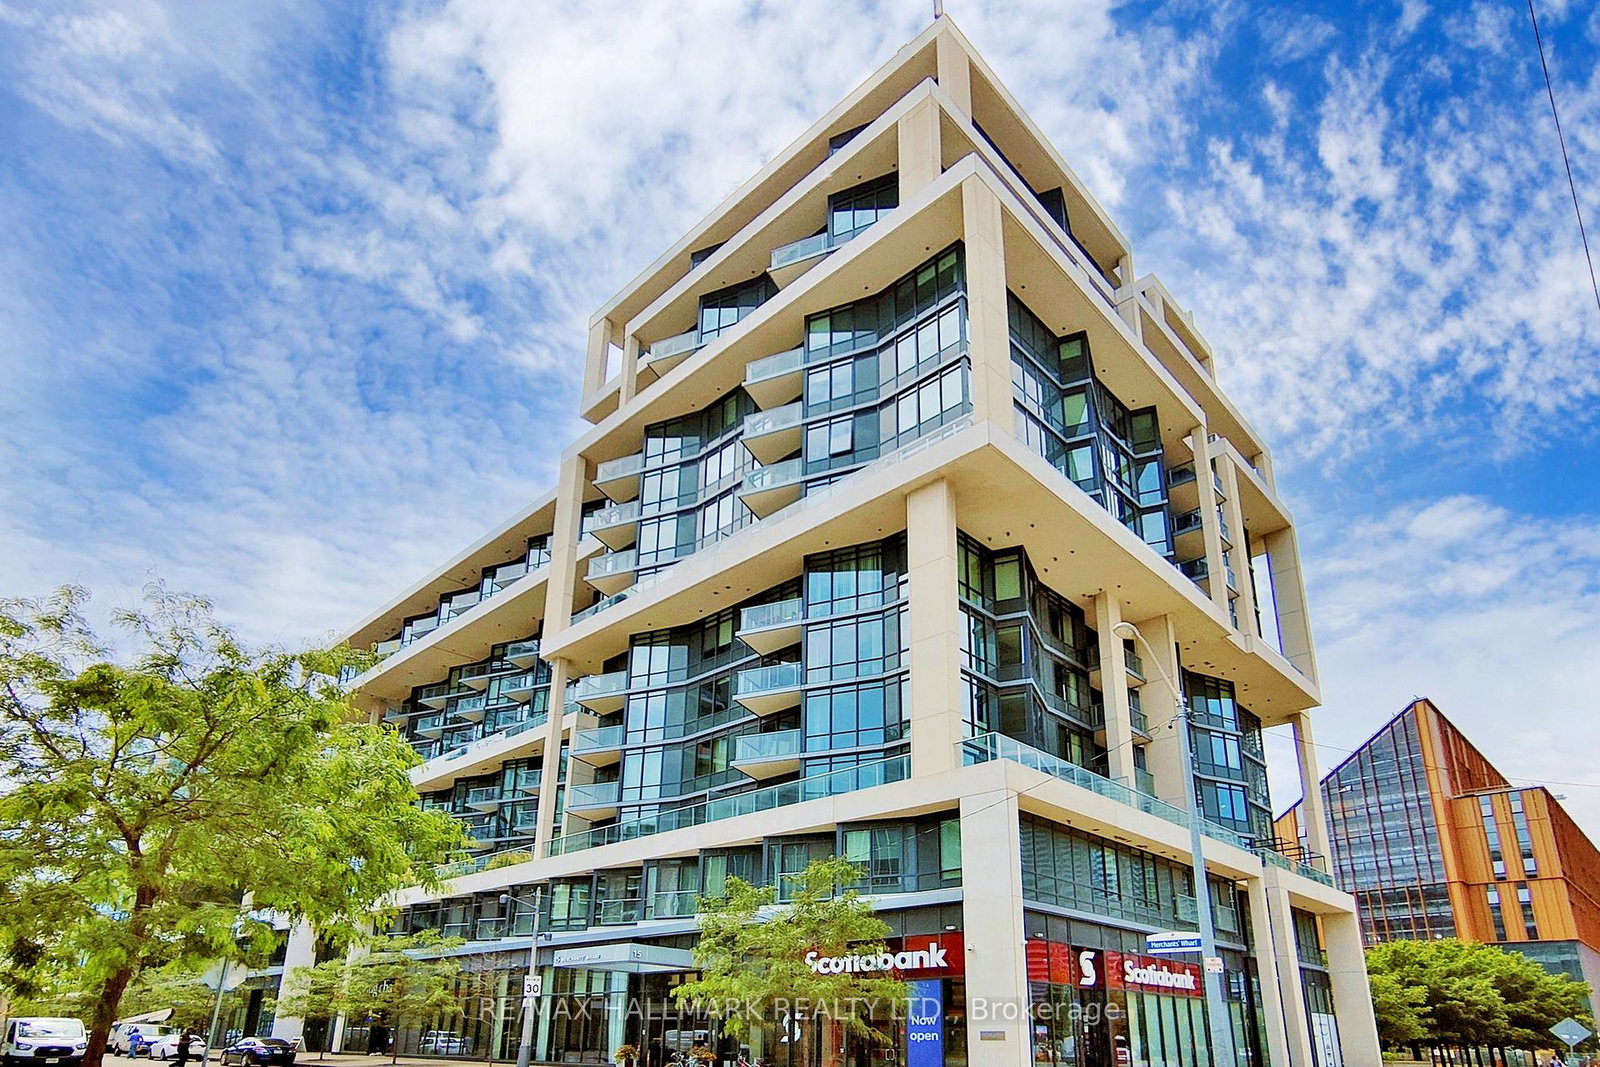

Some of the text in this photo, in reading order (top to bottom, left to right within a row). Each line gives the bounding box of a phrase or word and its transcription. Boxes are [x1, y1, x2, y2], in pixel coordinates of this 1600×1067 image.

[1180, 939, 1198, 947] Wharf
[632, 950, 642, 959] 15
[803, 942, 948, 975] Scotiabank
[1123, 960, 1196, 990] Scotiabank
[525, 983, 540, 994] 30
[911, 1015, 937, 1026] Now
[909, 1032, 939, 1044] open
